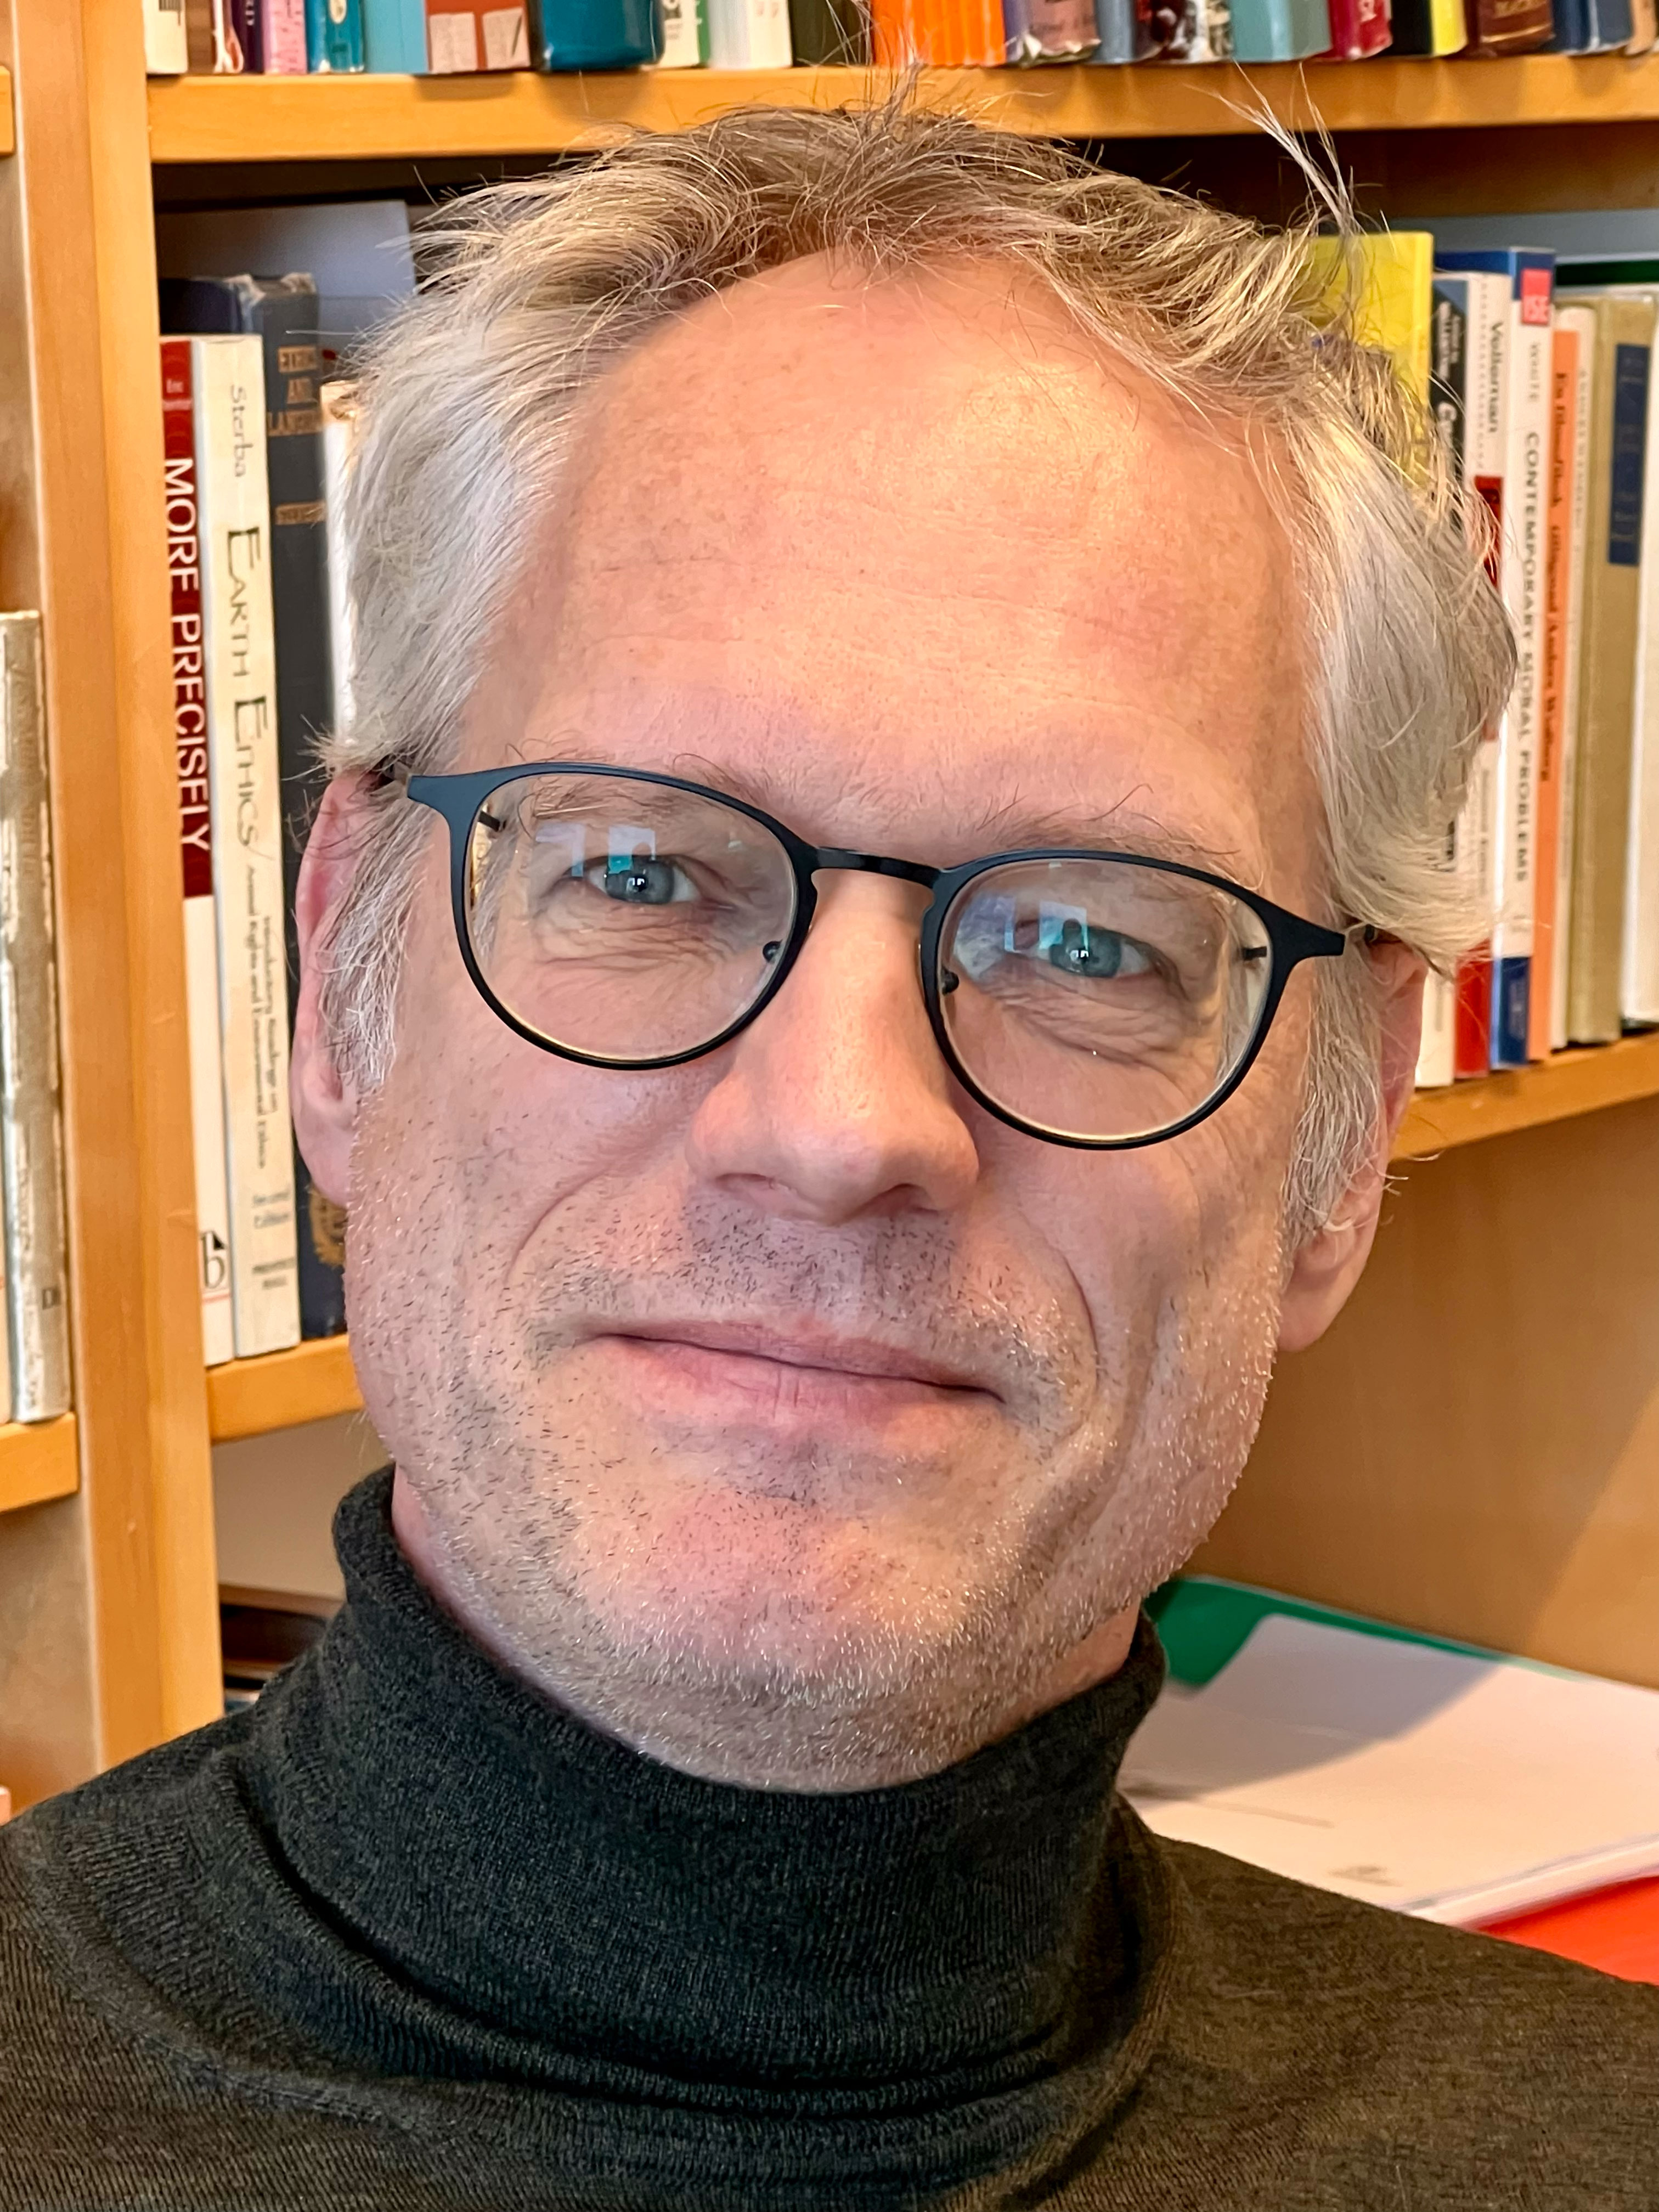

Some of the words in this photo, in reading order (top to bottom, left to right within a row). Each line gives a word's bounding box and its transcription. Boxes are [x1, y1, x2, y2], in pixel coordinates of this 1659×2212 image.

[230, 385, 253, 478] Sterba
[1487, 321, 1504, 433] Velleman
[1528, 342, 1540, 403] WHITE
[164, 458, 199, 592] MORE
[1523, 432, 1539, 638] CONTEMPORARY
[228, 527, 261, 677] EARTH
[1519, 653, 1533, 736] MORAL
[1516, 750, 1530, 881] PROBLEMS
